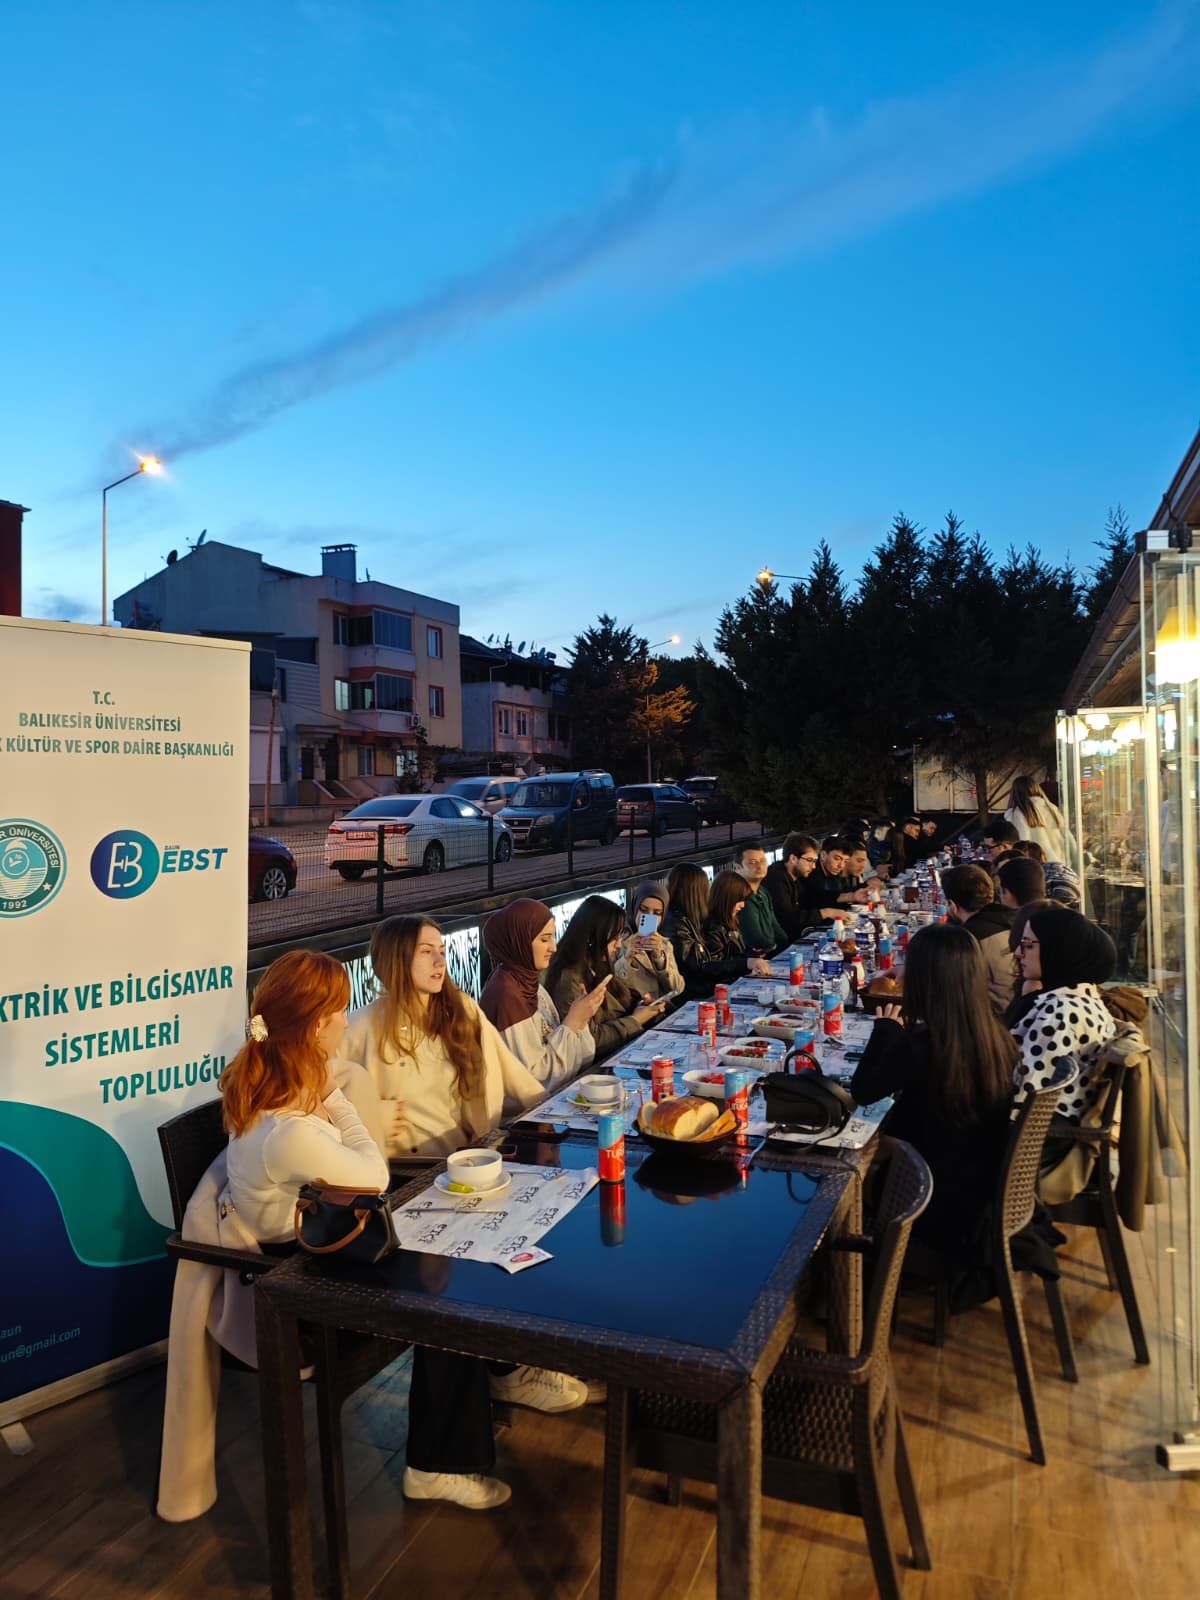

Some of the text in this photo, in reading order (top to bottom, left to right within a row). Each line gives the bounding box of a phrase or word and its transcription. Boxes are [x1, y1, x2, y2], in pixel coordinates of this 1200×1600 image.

[93, 691, 115, 705] T.C.
[19, 712, 181, 732] BALIKESİR ÜNİVERSİTESİ
[6, 735, 61, 752] KÜLTÜR
[65, 739, 82, 753] VE
[85, 740, 119, 753] SPOR
[123, 738, 161, 755] DAİRE
[164, 742, 234, 759] BAŞKANLIĞI
[161, 847, 228, 873] EBST
[2, 899, 28, 910] 1992
[75, 983, 103, 1011] VE
[109, 965, 233, 1006] BİLGİSAYAR
[45, 1014, 180, 1067] SİSTEMLERİ
[99, 1054, 226, 1104] TOPLULUĞU
